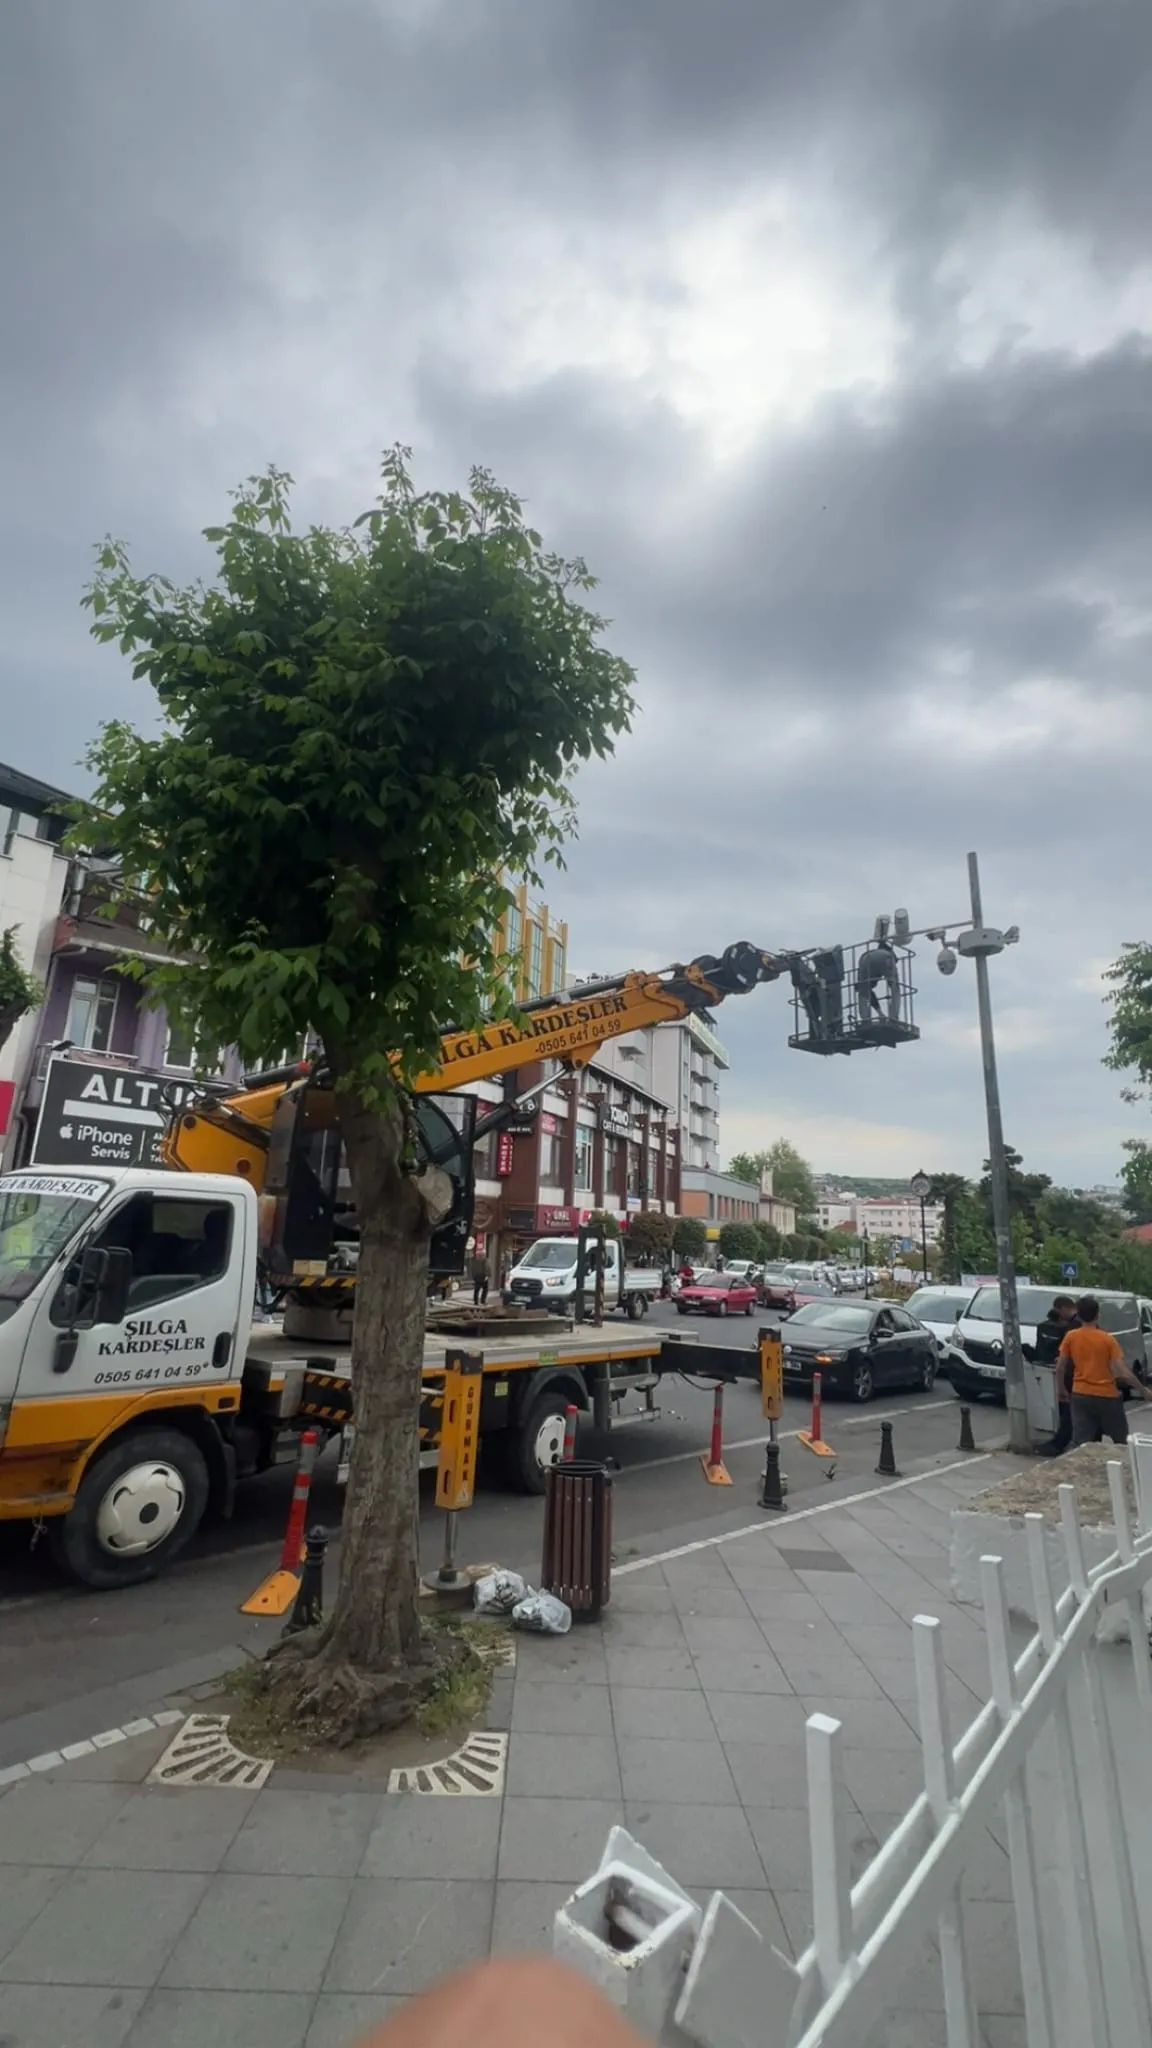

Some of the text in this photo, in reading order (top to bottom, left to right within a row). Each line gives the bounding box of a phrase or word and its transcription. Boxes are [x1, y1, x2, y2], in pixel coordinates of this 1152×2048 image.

[570, 1027, 588, 1045] 641
[592, 1022, 605, 1037] 04
[608, 1019, 621, 1033] 59
[77, 1125, 133, 1146] iPhone
[91, 1145, 131, 1160] Servis
[124, 1319, 188, 1340] ŞILGA
[98, 1336, 206, 1355] KARDEŞLER
[94, 1370, 131, 1384] 0505
[135, 1368, 161, 1381] 641
[164, 1366, 182, 1378] 04
